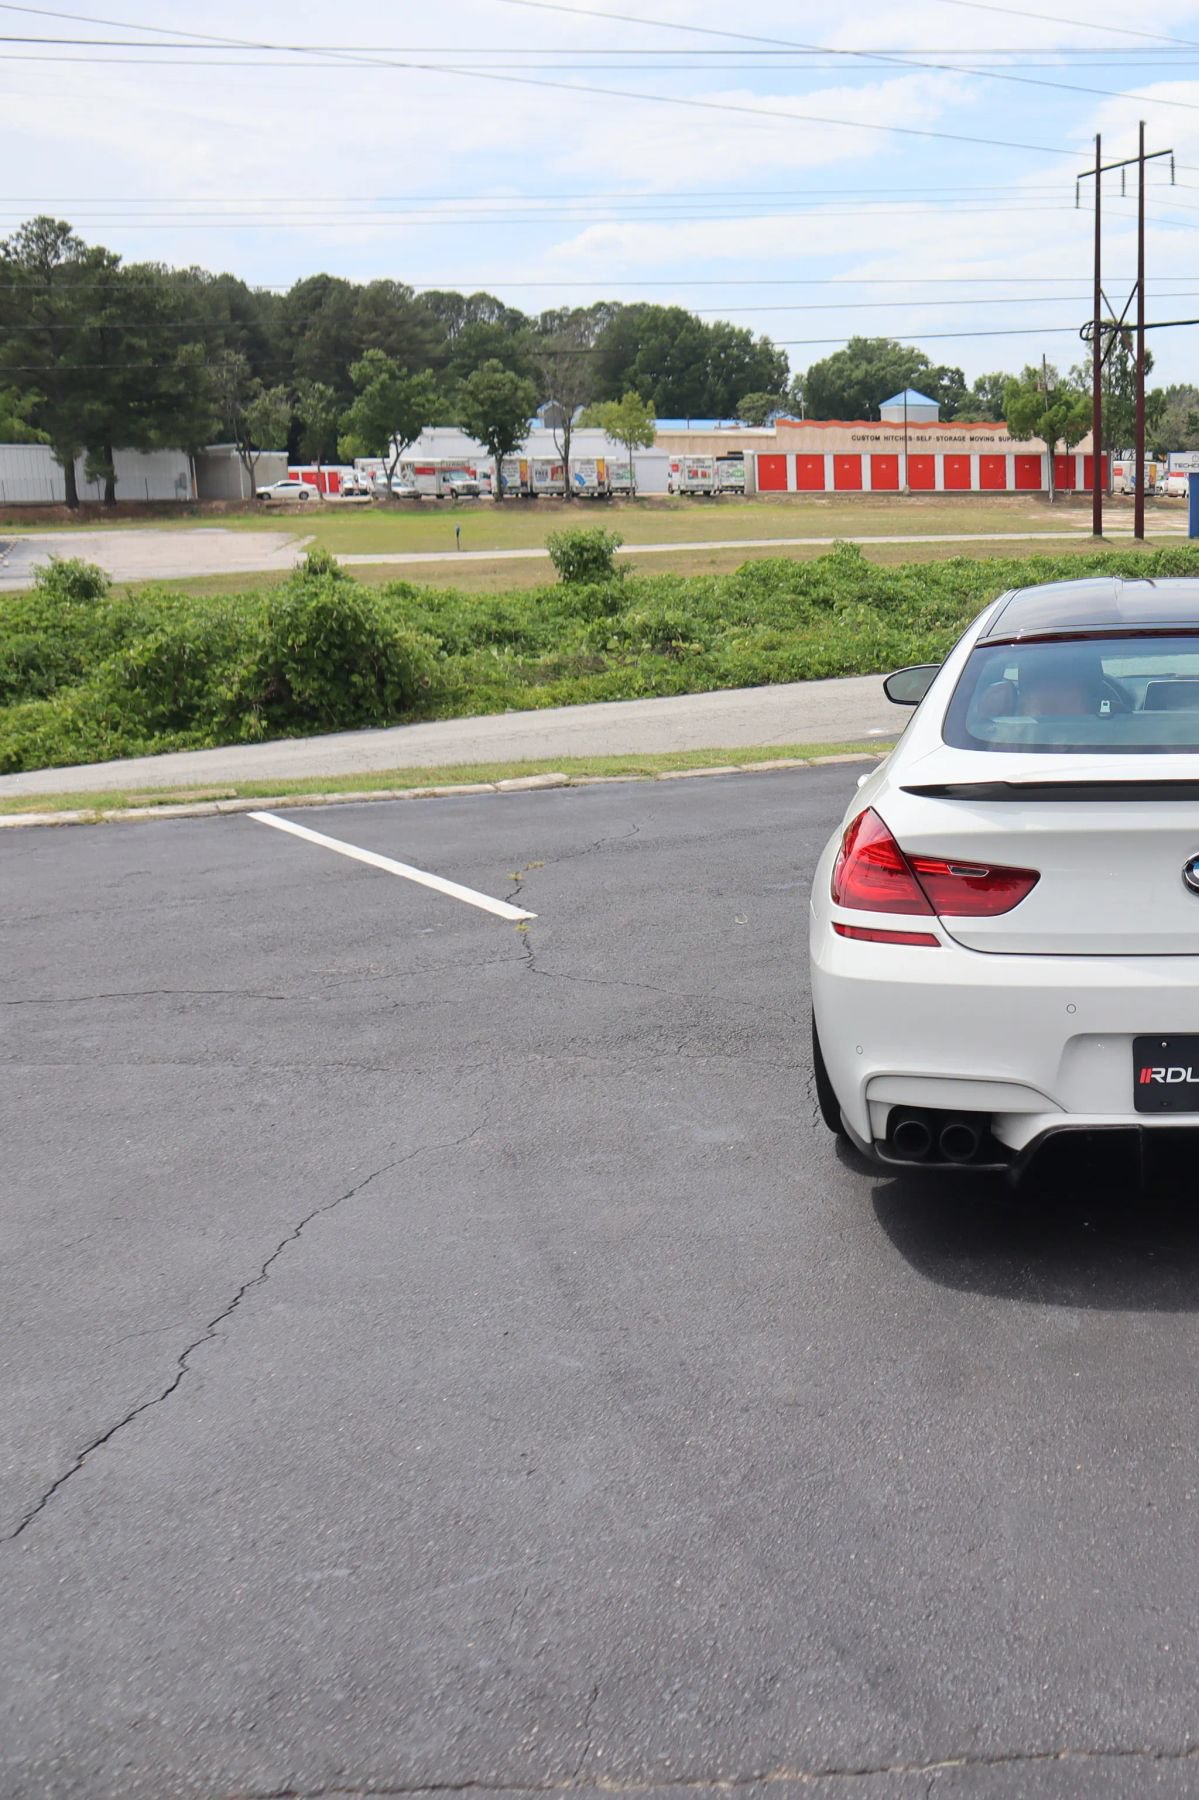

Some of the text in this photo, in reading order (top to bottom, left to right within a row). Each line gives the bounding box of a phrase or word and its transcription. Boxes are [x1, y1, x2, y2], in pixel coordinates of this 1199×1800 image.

[852, 434, 880, 442] CUSTOM
[883, 434, 912, 442] HITCHS
[969, 435, 995, 443] MOVING
